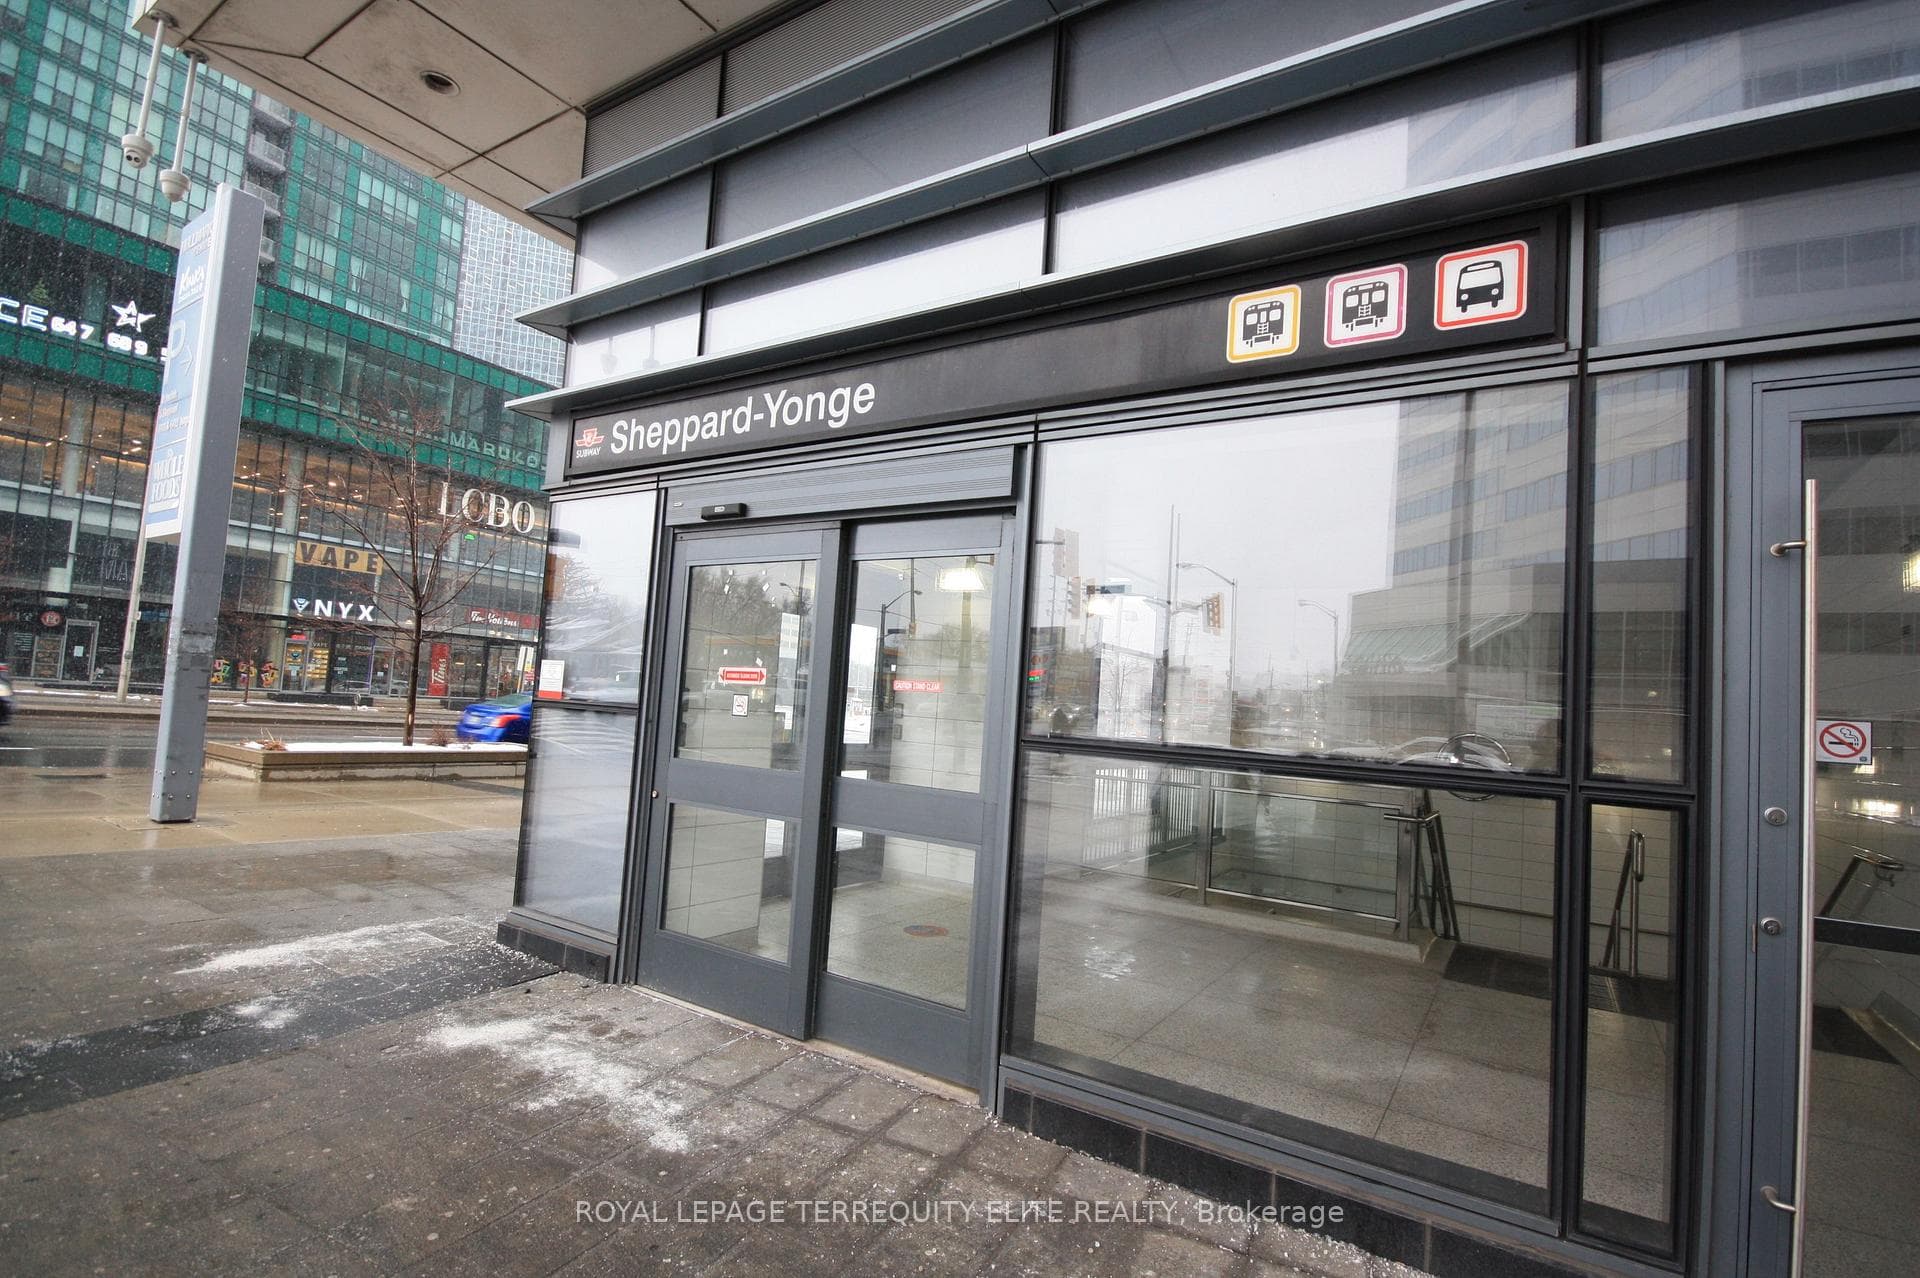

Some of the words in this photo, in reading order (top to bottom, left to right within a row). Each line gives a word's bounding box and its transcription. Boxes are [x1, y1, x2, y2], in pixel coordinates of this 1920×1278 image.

[610, 382, 875, 455] Sheppard-Yonge
[576, 447, 601, 458] SUBWAY
[438, 480, 535, 533] LCBO
[300, 542, 378, 572] VAPE
[432, 658, 446, 684] Tims
